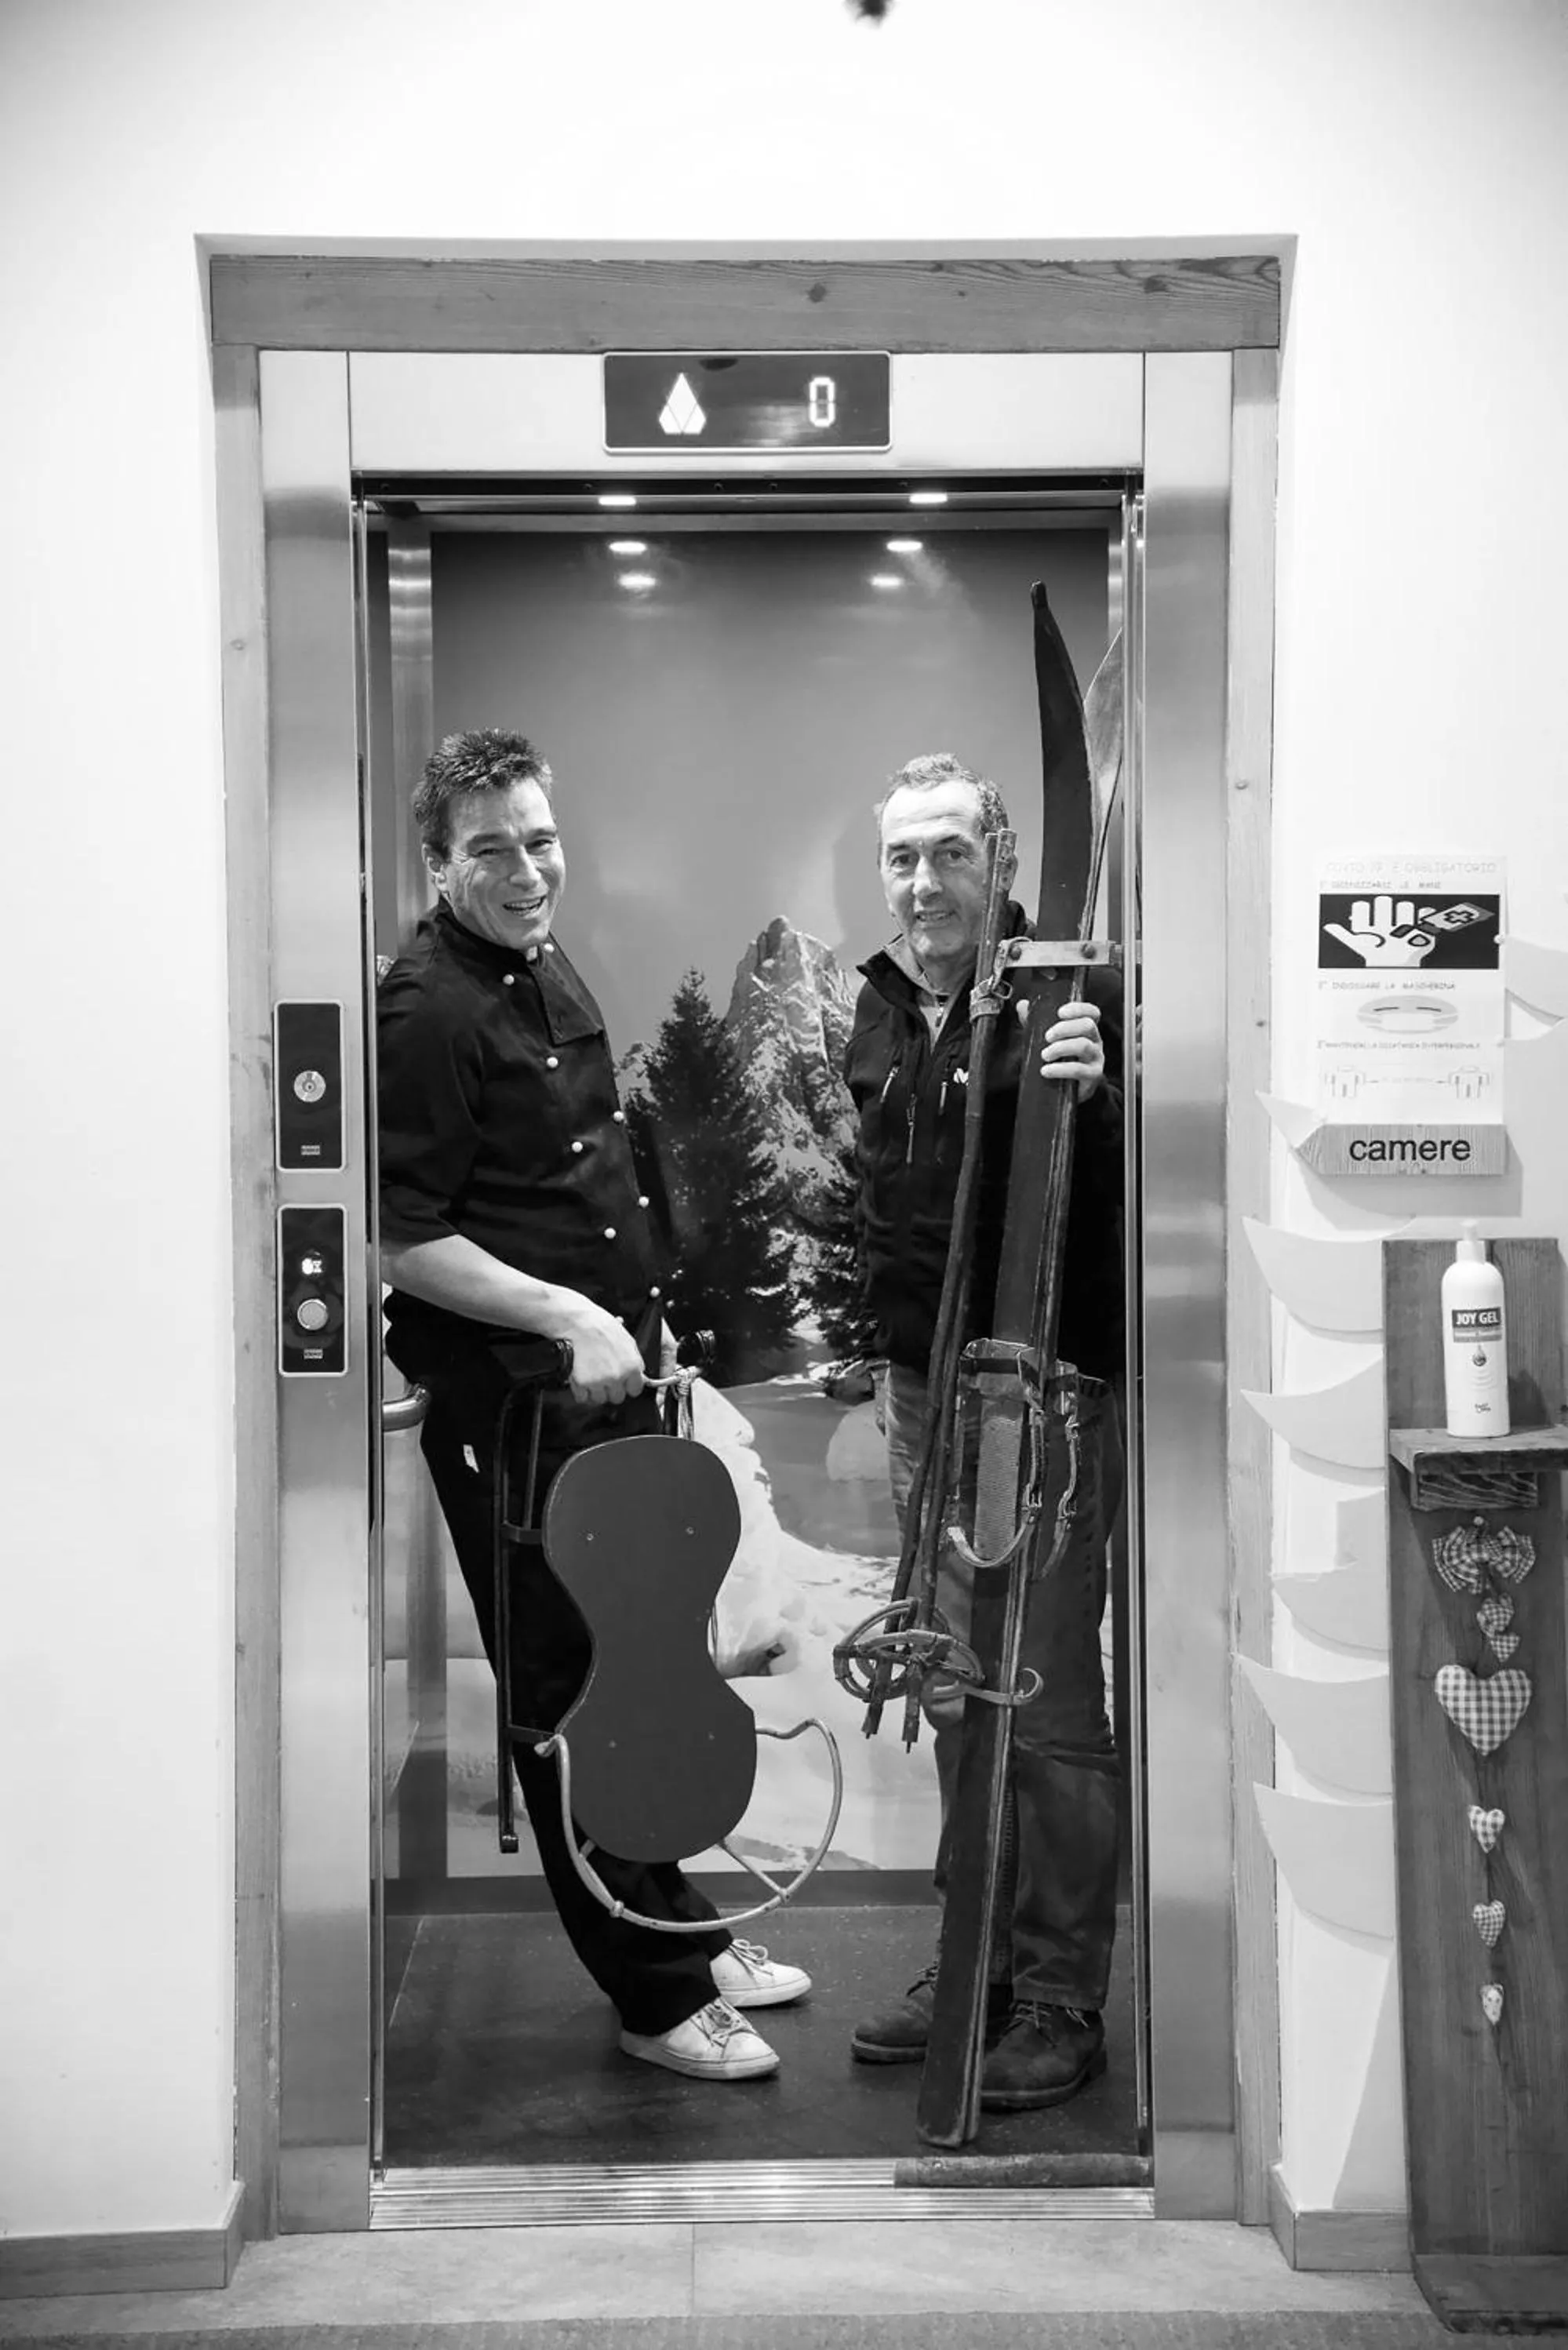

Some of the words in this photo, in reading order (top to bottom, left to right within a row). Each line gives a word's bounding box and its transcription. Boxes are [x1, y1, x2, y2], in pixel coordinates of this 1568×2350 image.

[809, 376, 835, 428] 0
[1349, 1140, 1471, 1161] camere
[1456, 1312, 1476, 1325] JOY
[1479, 1311, 1498, 1324] GEL
